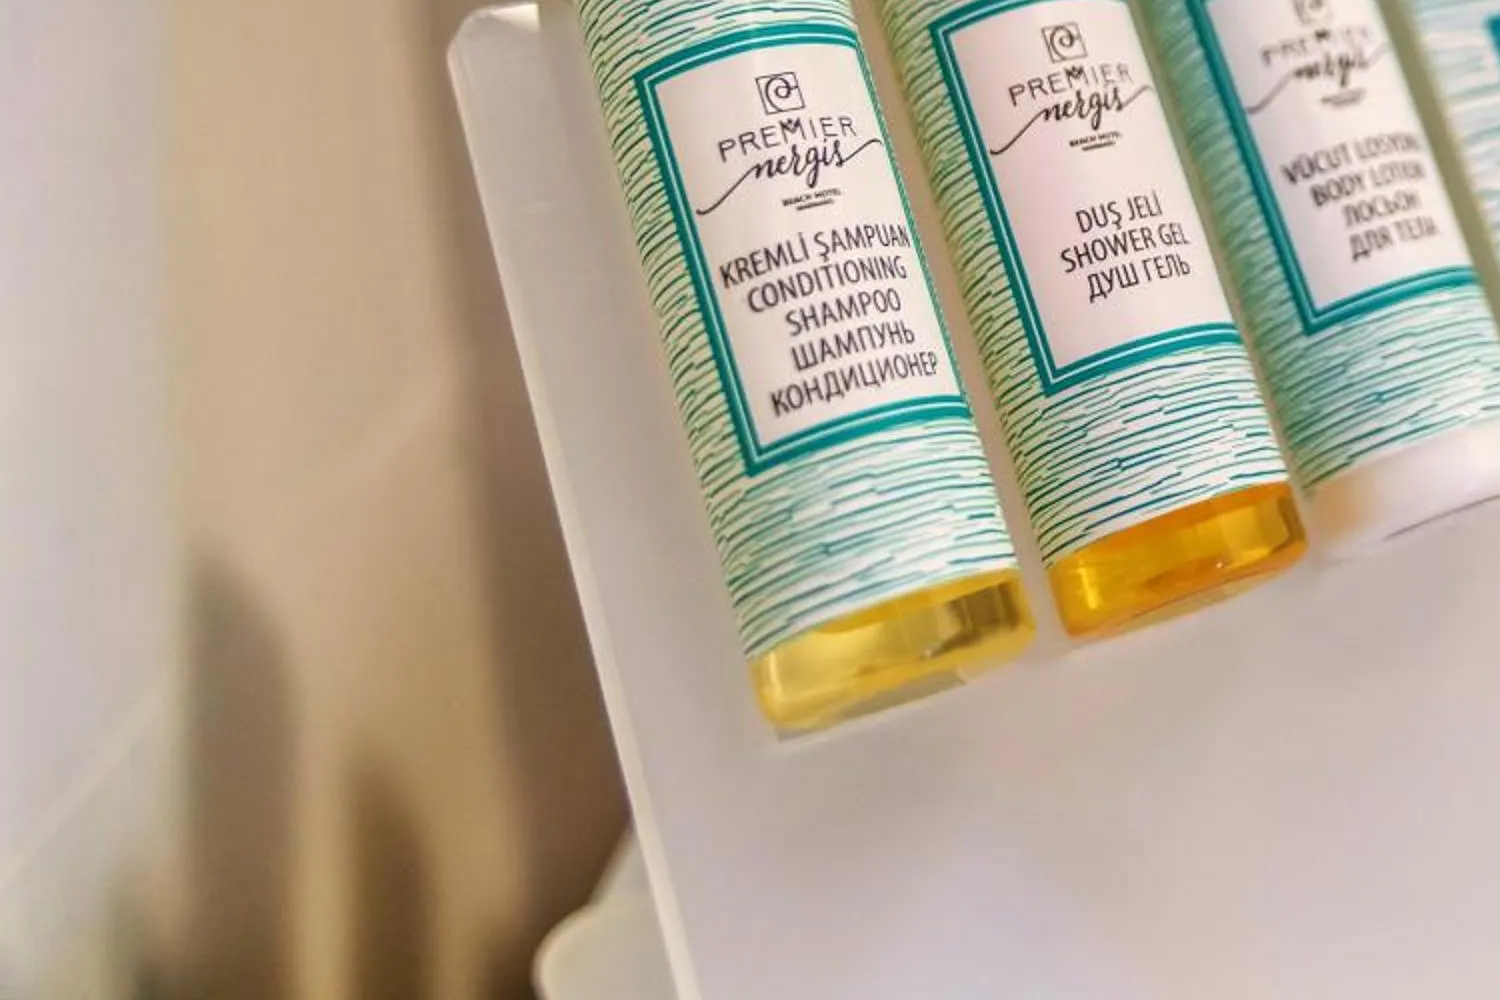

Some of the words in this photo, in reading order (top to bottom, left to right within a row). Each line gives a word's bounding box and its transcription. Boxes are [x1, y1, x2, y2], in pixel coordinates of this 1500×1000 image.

[1009, 62, 1134, 106] PREMIER
[718, 116, 857, 163] PREMIER
[1310, 173, 1365, 206] BODY
[1075, 200, 1123, 234] DUŞ
[720, 232, 810, 289] KREMLİ
[813, 223, 911, 261] ŞAMPUAN
[1060, 226, 1159, 273] SHOWER
[1160, 222, 1191, 247] GEL
[747, 255, 908, 313] CONDITIONING
[1088, 261, 1139, 303] ДУШ
[1142, 254, 1191, 283] ГЕЛЬ
[785, 287, 901, 337] SHAMPOO
[791, 320, 915, 372] ШАМПУНЬ
[770, 351, 938, 417] КОНДИЦИОНЕР
